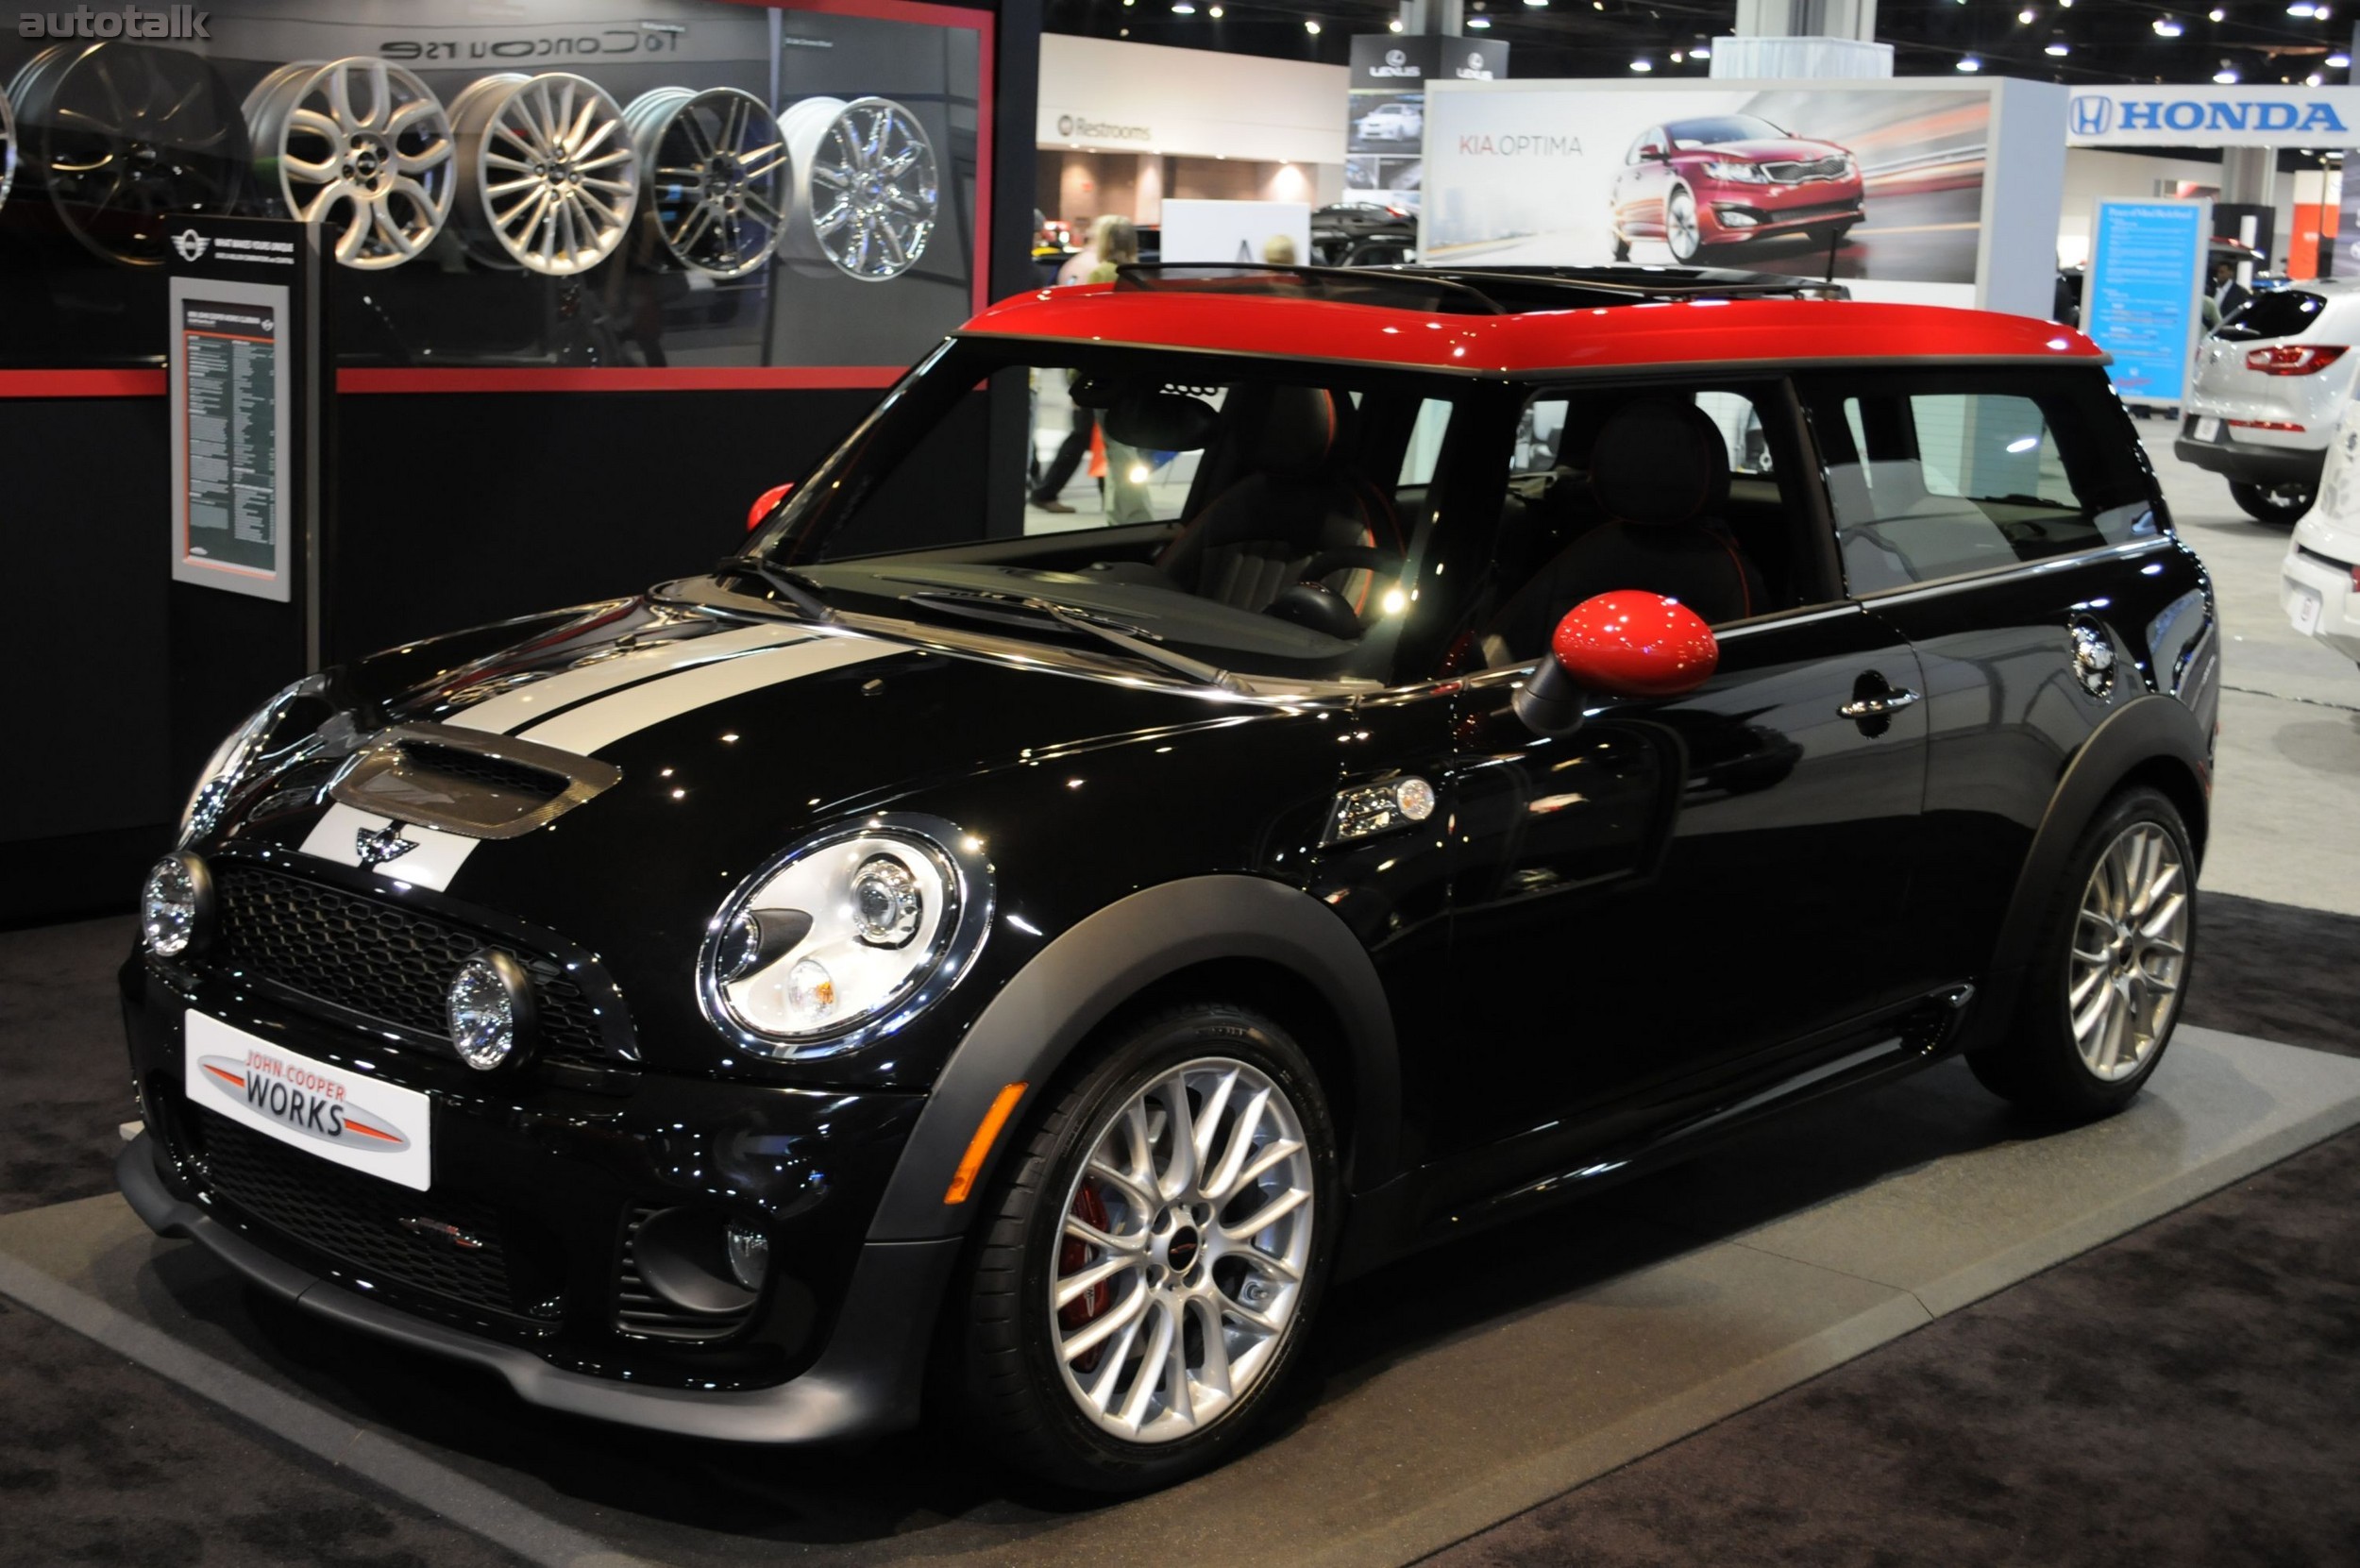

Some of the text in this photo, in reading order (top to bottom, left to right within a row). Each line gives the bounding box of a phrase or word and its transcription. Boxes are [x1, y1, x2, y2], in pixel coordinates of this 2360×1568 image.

[1369, 65, 1421, 77] LEXUS
[1076, 116, 1152, 142] Restrooms
[2117, 101, 2349, 132] HONDA
[244, 1051, 346, 1102] JOHN COOPER
[245, 1070, 345, 1137] WORKS
